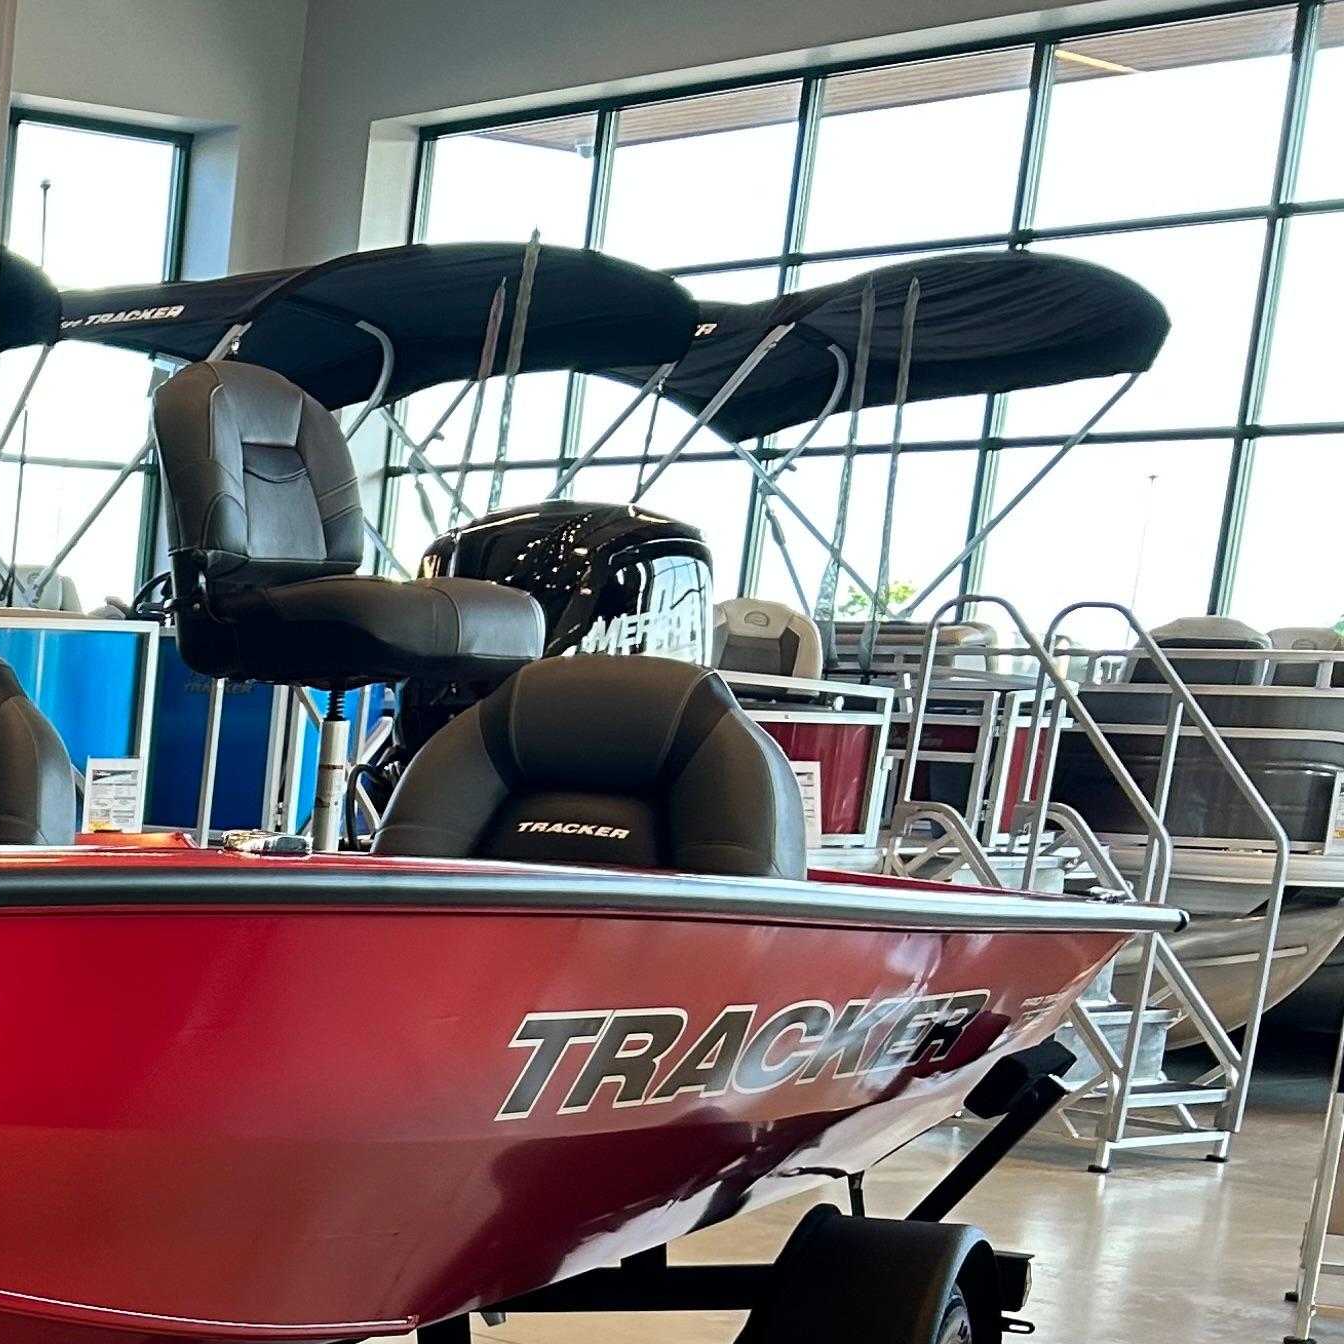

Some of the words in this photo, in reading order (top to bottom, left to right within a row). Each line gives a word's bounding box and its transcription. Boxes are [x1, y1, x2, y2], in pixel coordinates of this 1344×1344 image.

[84, 304, 185, 326] TRACKER
[517, 821, 630, 839] TRACKER
[494, 988, 991, 1122] TRACKER
